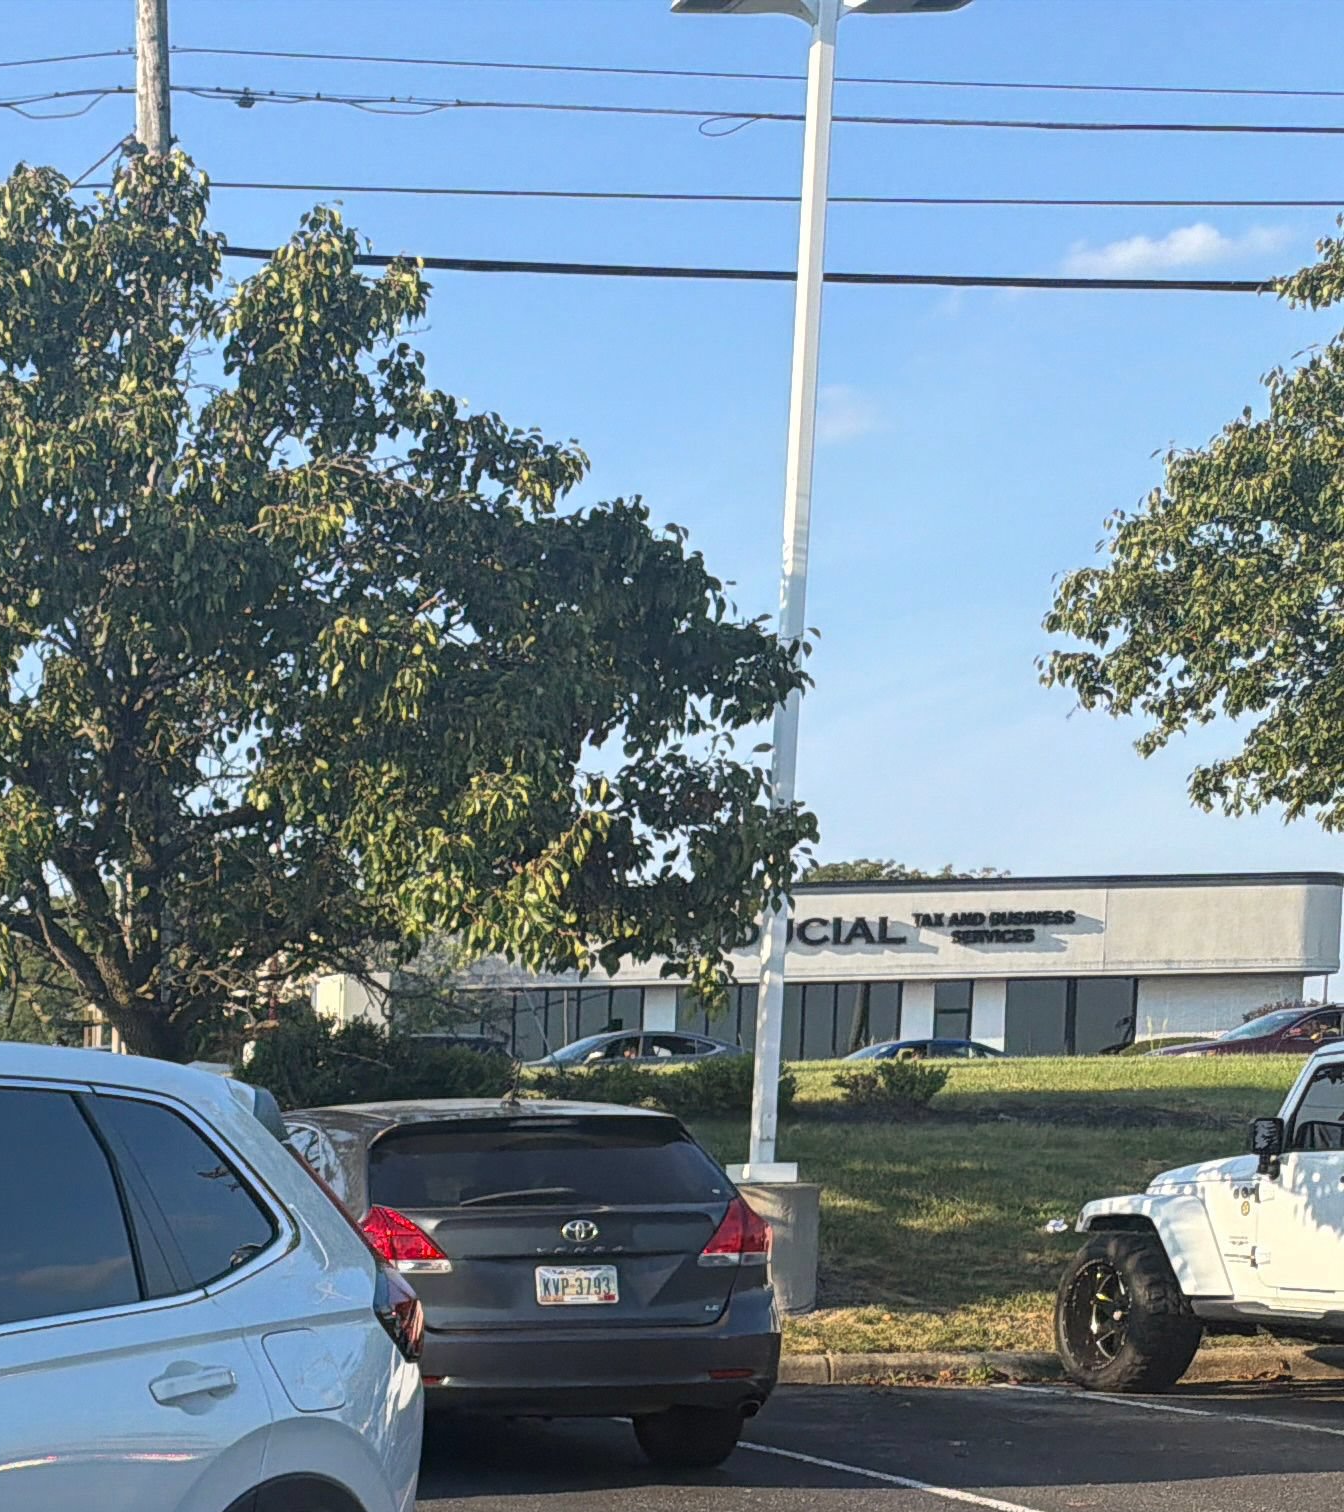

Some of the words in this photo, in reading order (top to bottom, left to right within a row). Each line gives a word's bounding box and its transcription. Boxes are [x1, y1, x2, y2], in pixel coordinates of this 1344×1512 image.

[912, 912, 944, 928] TAX
[948, 911, 985, 928] AND
[989, 909, 1077, 927] BUSINESS
[951, 928, 1036, 944] SERVICES
